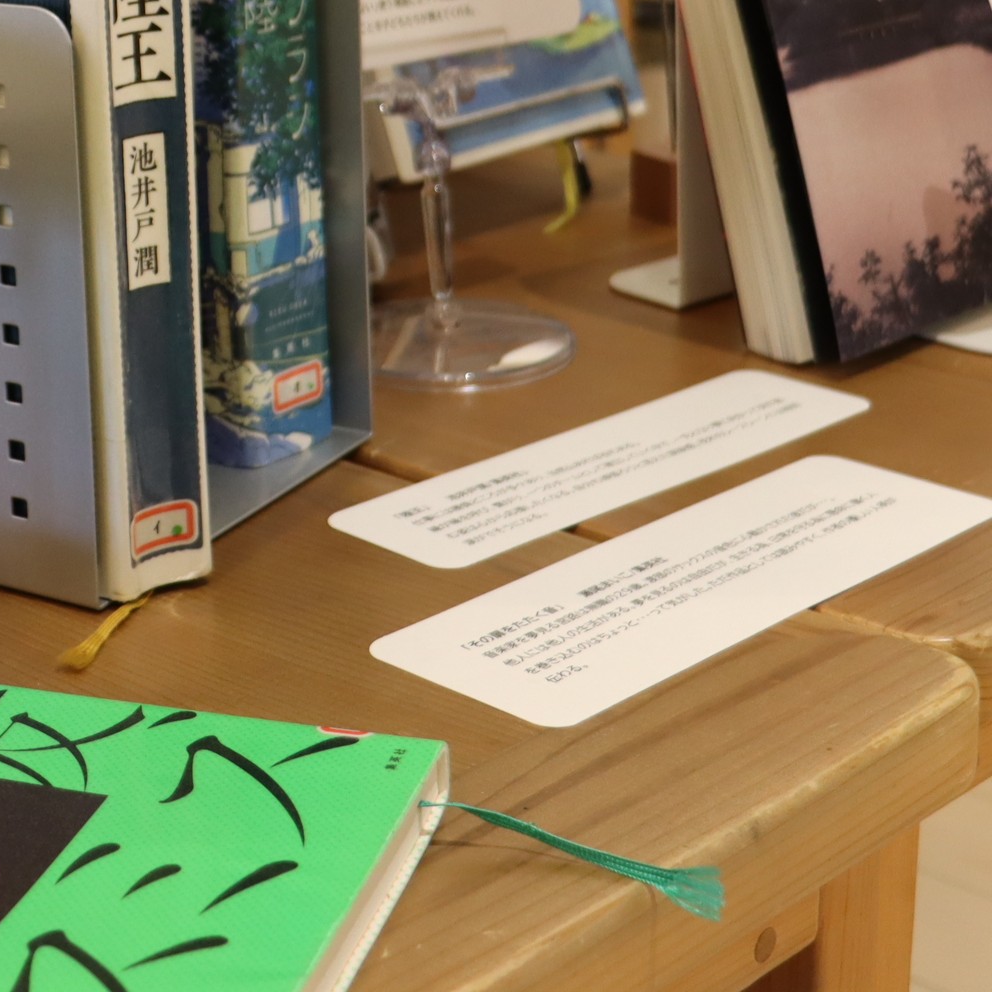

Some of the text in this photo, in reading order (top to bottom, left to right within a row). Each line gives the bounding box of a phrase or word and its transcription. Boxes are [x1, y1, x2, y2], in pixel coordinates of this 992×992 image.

[128, 145, 159, 278] 池井戸潤
[545, 663, 589, 684] 伝わる。
